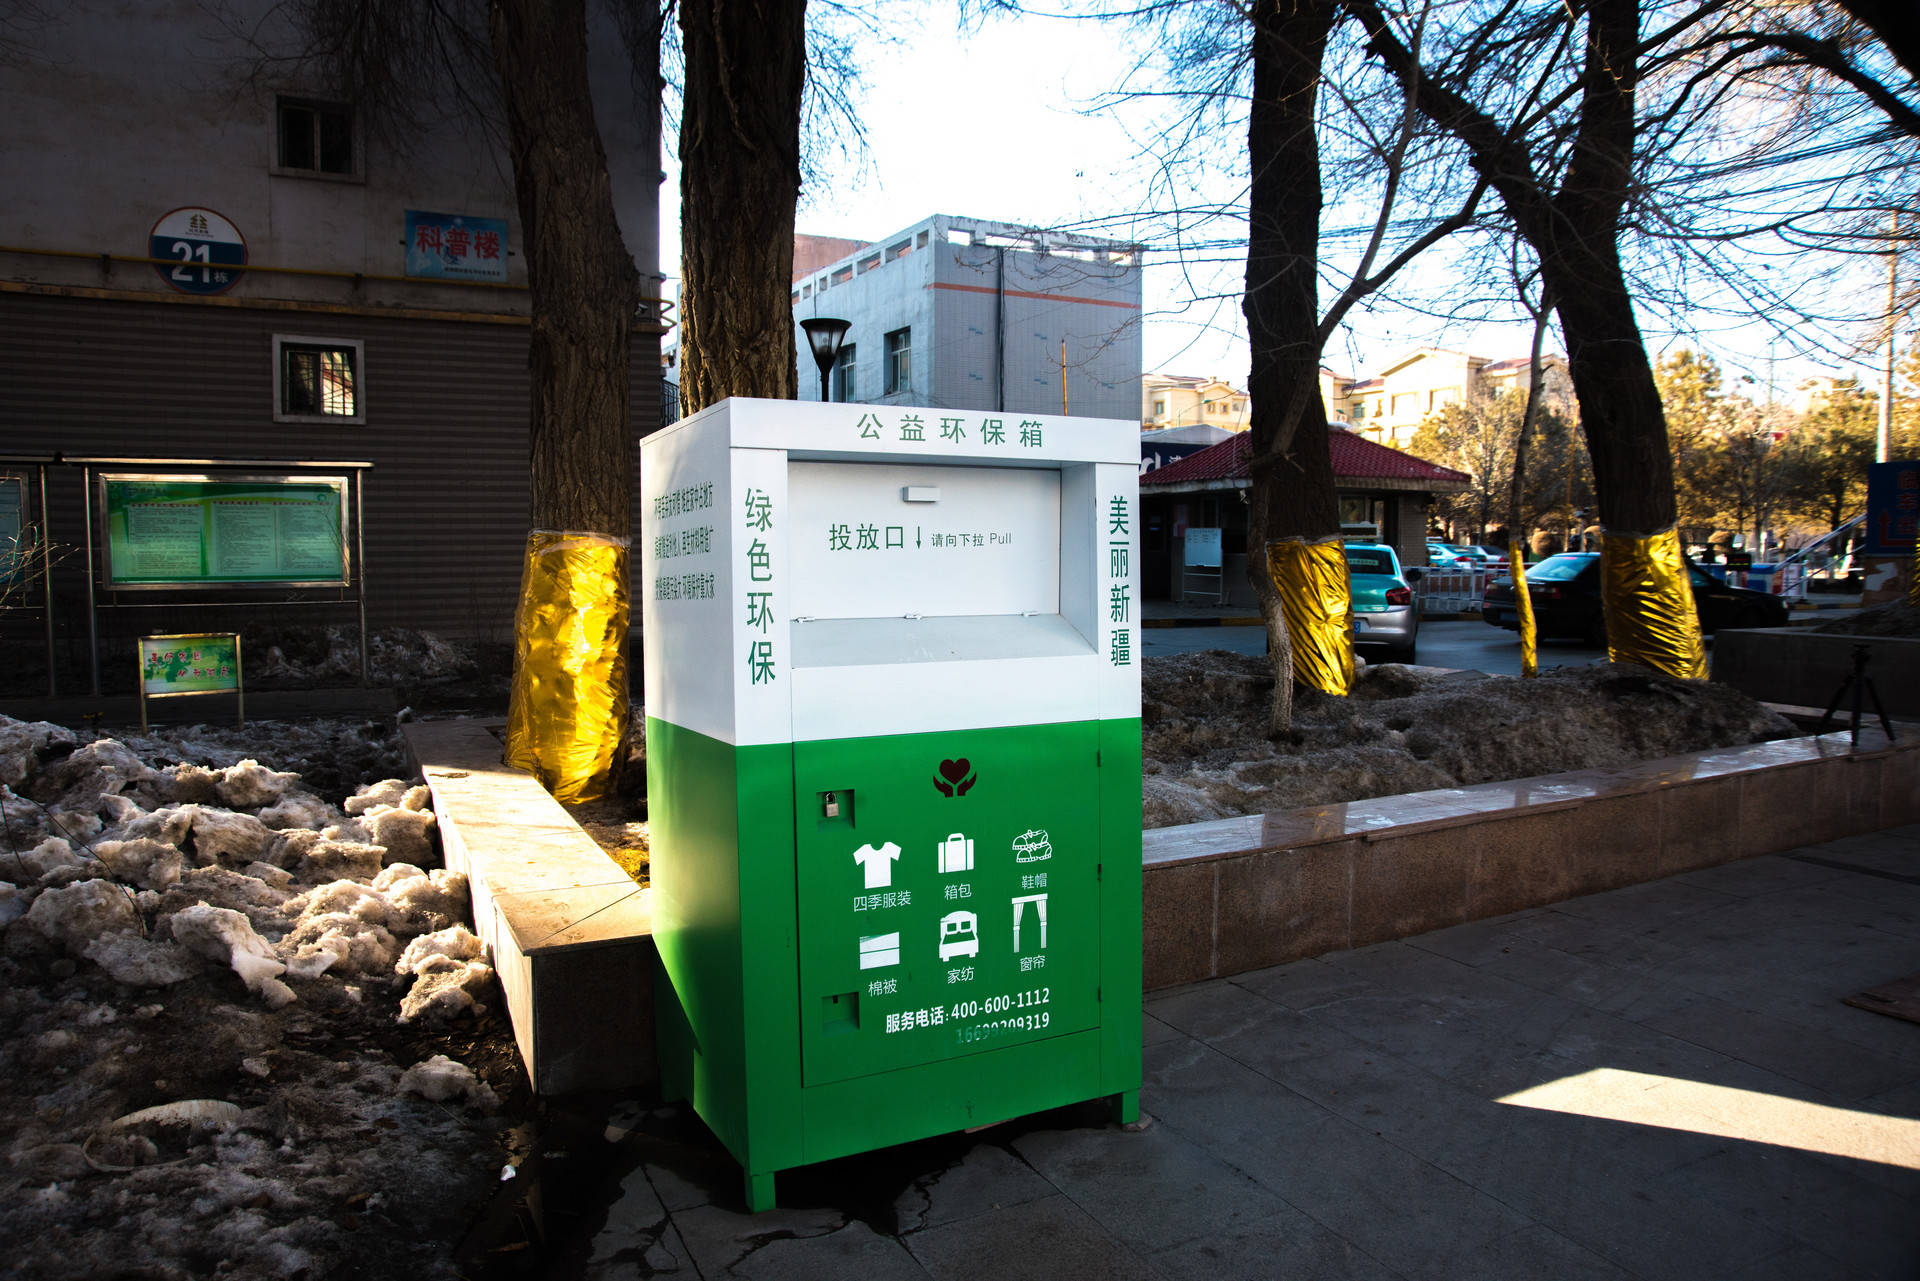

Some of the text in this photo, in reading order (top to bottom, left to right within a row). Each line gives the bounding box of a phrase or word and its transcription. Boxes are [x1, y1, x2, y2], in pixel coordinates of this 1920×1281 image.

[416, 225, 499, 260] 科普楼
[856, 412, 1044, 448] 公益环保箱
[829, 523, 1012, 551] 投放口 请向下拉 Pull
[745, 487, 776, 687] 绿色环保
[1109, 495, 1132, 667] 美丽新疆
[944, 883, 972, 900] 箱包
[1021, 872, 1048, 890] 鞋帽
[853, 890, 912, 912] 四季服装
[1019, 955, 1046, 972] 窗帘
[947, 966, 975, 984] 家纺
[868, 978, 898, 997] 棉被
